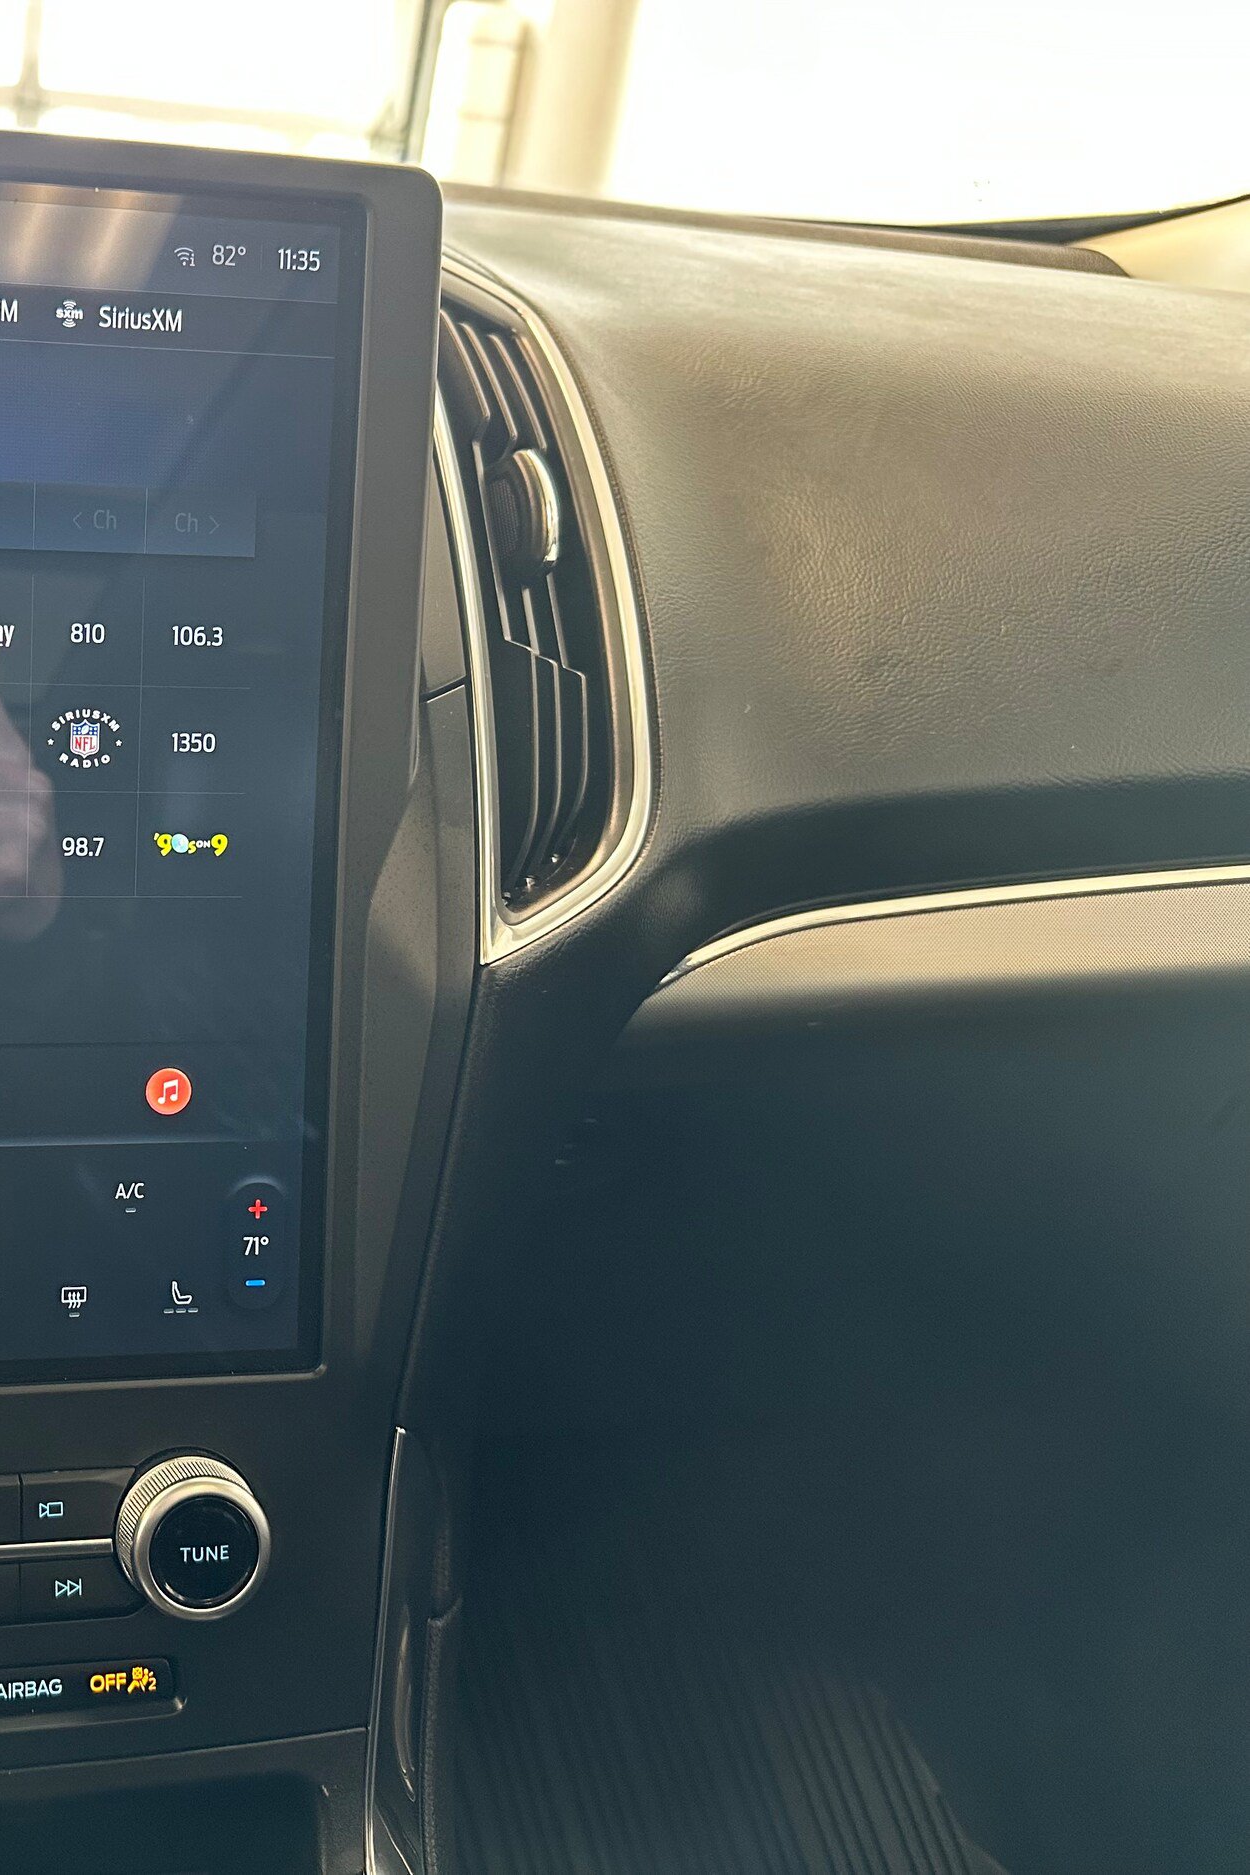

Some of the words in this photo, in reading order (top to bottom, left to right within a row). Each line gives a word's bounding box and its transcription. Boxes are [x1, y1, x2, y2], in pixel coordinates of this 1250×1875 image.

[277, 248, 321, 272] 11:35
[98, 305, 183, 333] SiriusXM
[92, 509, 117, 530] Ch
[174, 512, 199, 534] Ch
[70, 623, 105, 644] 810
[171, 625, 223, 647] 106.3
[51, 708, 121, 733] SIRIUSXM
[74, 736, 96, 751] NFL
[171, 732, 216, 753] 1350
[58, 752, 111, 769] RADIO
[62, 837, 105, 857] 98.7
[114, 1182, 145, 1200] A/C
[180, 1544, 230, 1563] TUNE
[90, 1672, 127, 1694] OFF
